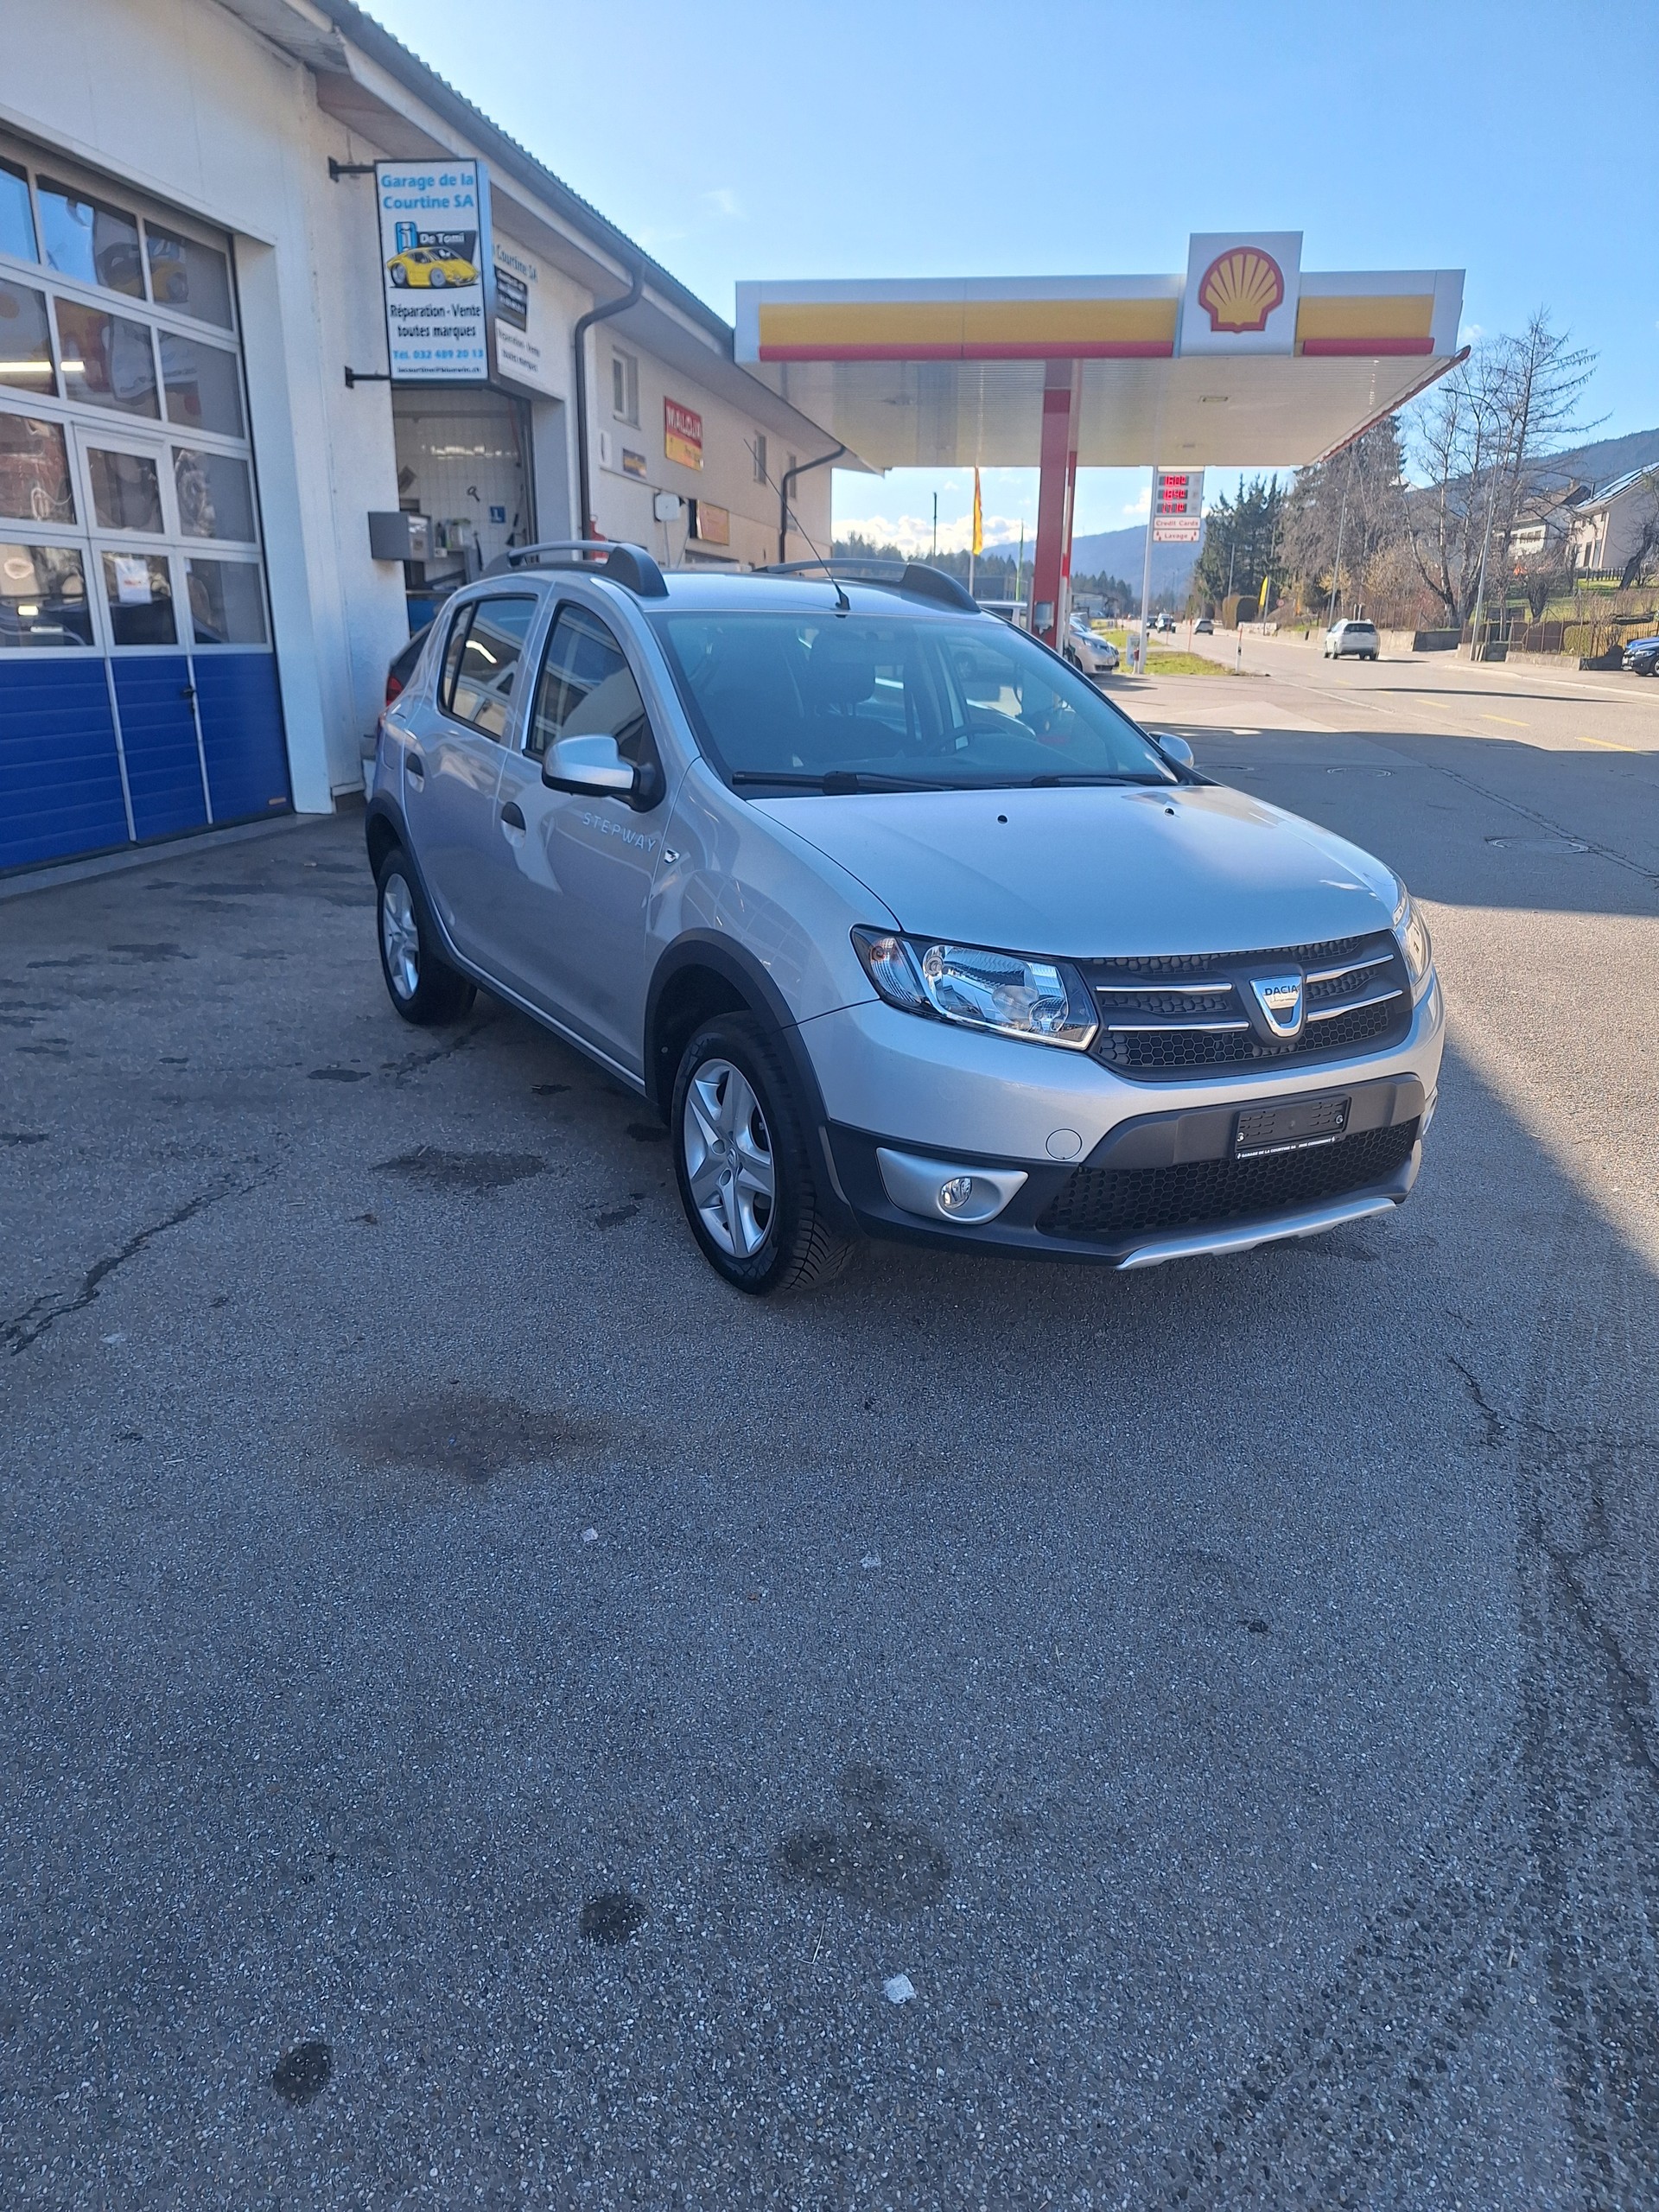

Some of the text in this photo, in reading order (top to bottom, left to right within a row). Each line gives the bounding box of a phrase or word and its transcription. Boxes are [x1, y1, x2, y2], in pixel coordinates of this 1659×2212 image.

[381, 172, 474, 190] Garage de la
[383, 194, 474, 209] Courtine SA
[390, 304, 445, 321] Réparation
[451, 304, 481, 317] Vente
[397, 326, 476, 340] toutes marques
[413, 349, 431, 359] 032
[456, 348, 468, 359] 20
[582, 812, 656, 852] STEPWAY
[1264, 984, 1299, 996] DACIA
